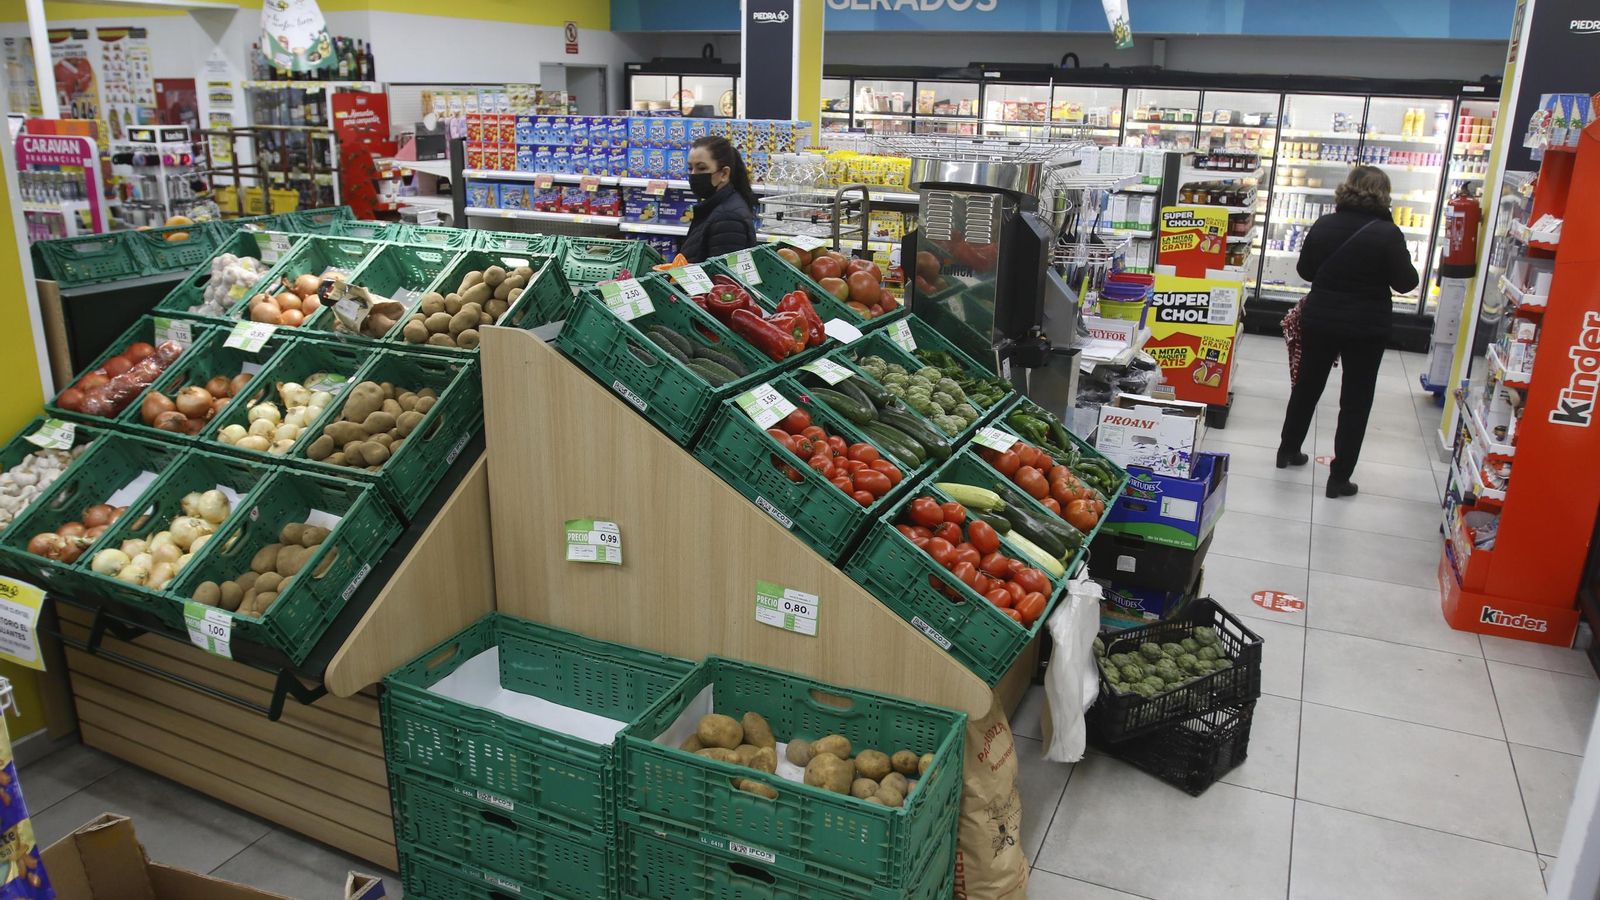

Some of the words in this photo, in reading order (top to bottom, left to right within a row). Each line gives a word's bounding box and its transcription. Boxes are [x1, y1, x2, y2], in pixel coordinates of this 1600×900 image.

[753, 12, 776, 20] PIEDRA
[23, 138, 80, 154] CARAVAN
[26, 154, 81, 163] FRAGANCIAS
[1162, 242, 1193, 251] GRATIS
[1153, 292, 1208, 306] SÚPER
[1161, 309, 1208, 322] CHOL
[1202, 340, 1229, 350] GRATIS
[1157, 358, 1186, 367] ATIS
[1103, 415, 1155, 429] PROANI
[567, 532, 588, 542] PRECIO
[757, 594, 778, 608] PRECIO
[784, 601, 807, 614] 0,80
[749, 847, 765, 857] IFCO
